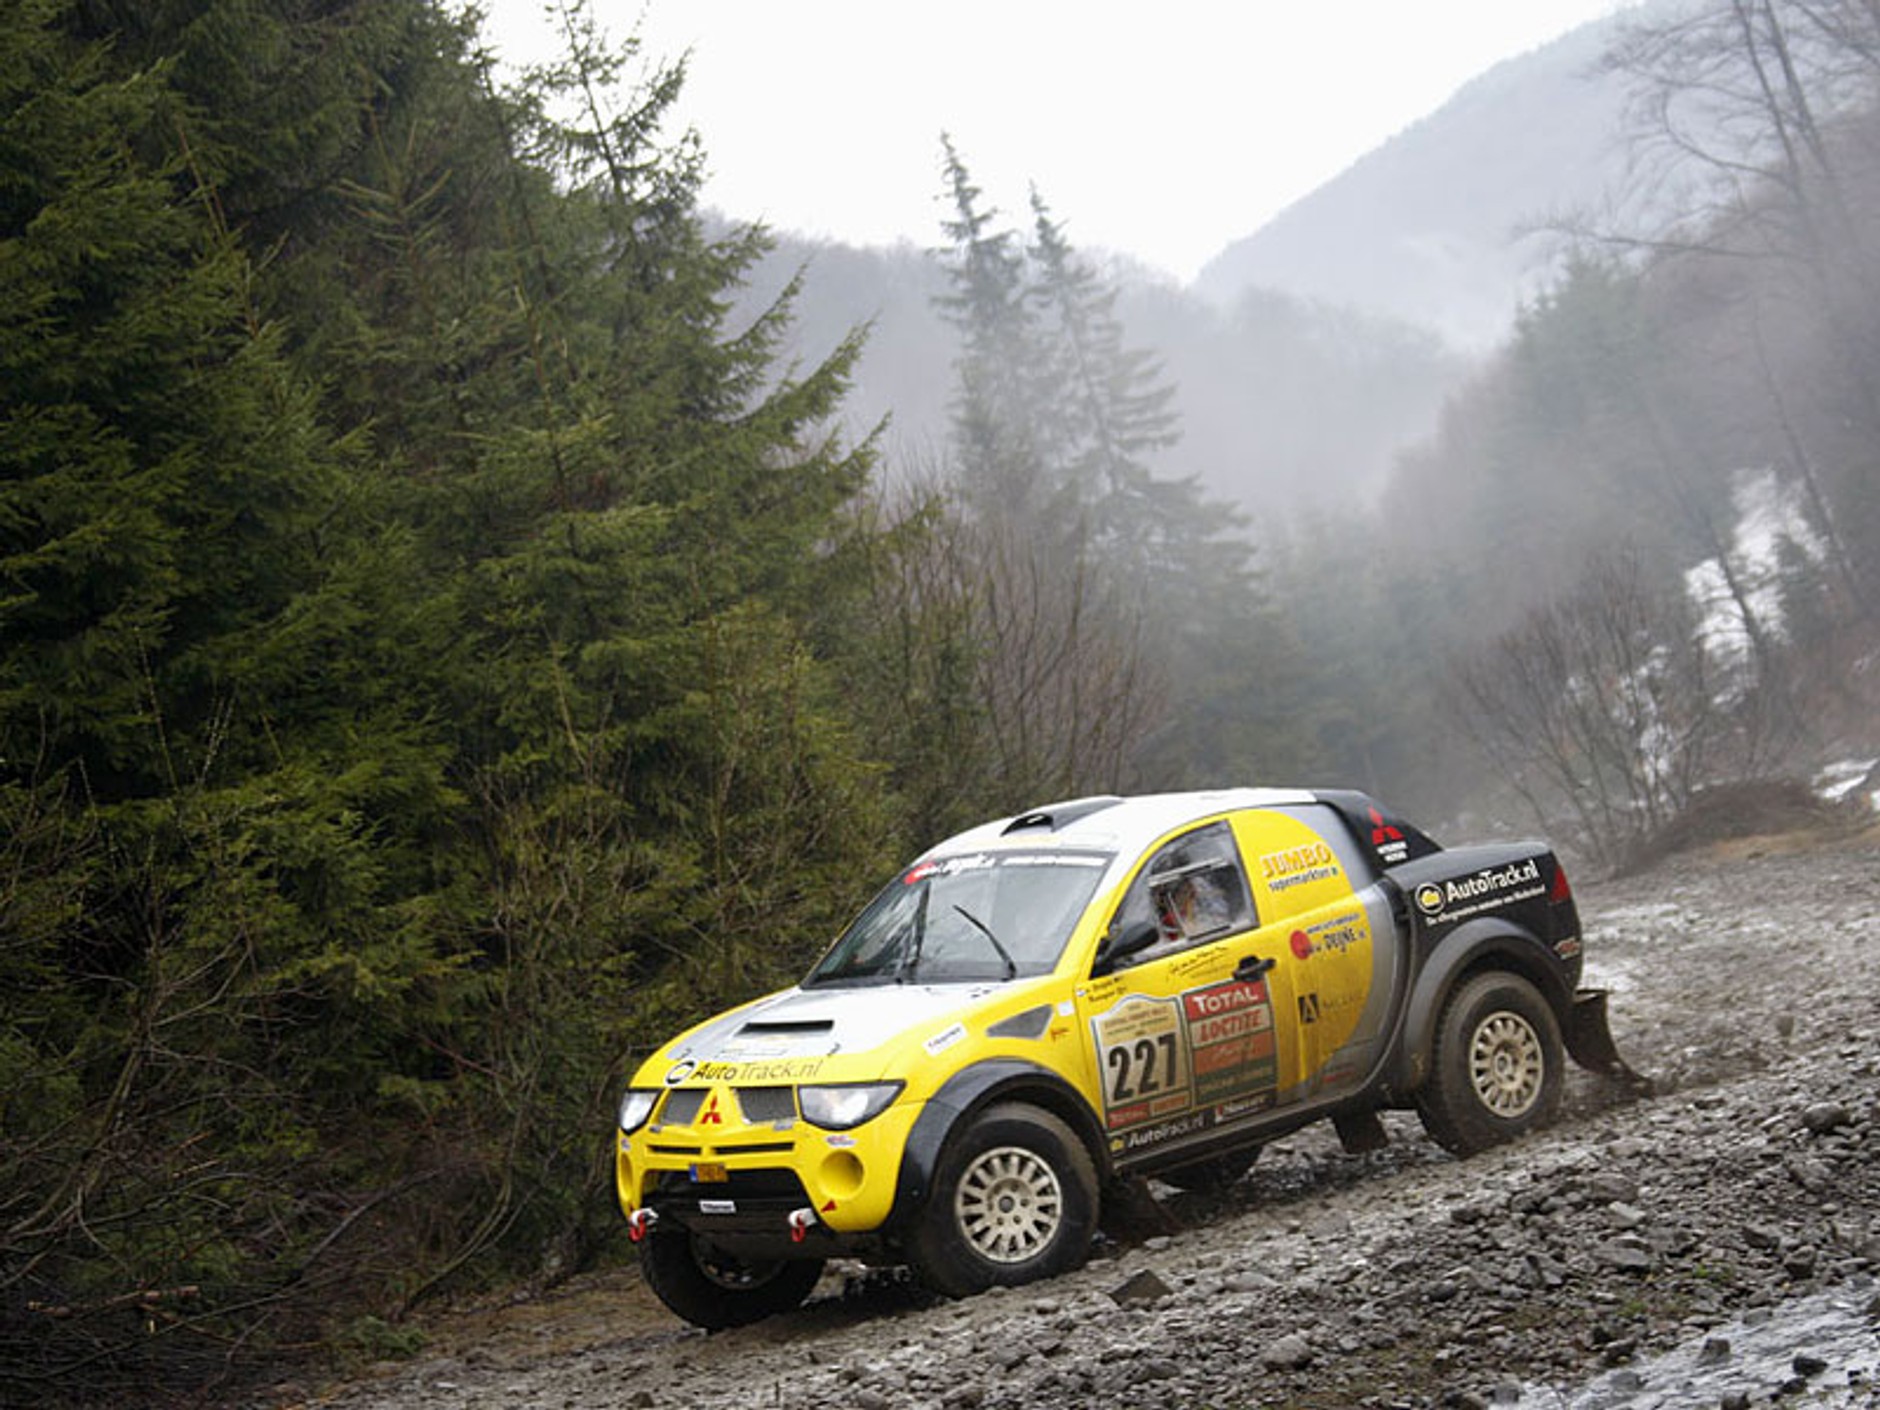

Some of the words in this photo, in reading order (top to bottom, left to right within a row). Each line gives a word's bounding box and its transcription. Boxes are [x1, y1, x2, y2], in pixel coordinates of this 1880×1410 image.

[1260, 841, 1332, 877] JUMBO
[1447, 859, 1540, 902] AutoTrack.nl
[1194, 986, 1258, 1014] TOTAL
[1200, 1009, 1262, 1043] LOCTITE
[691, 1060, 823, 1081] AutoTrack.nl
[1109, 1032, 1176, 1100] 227
